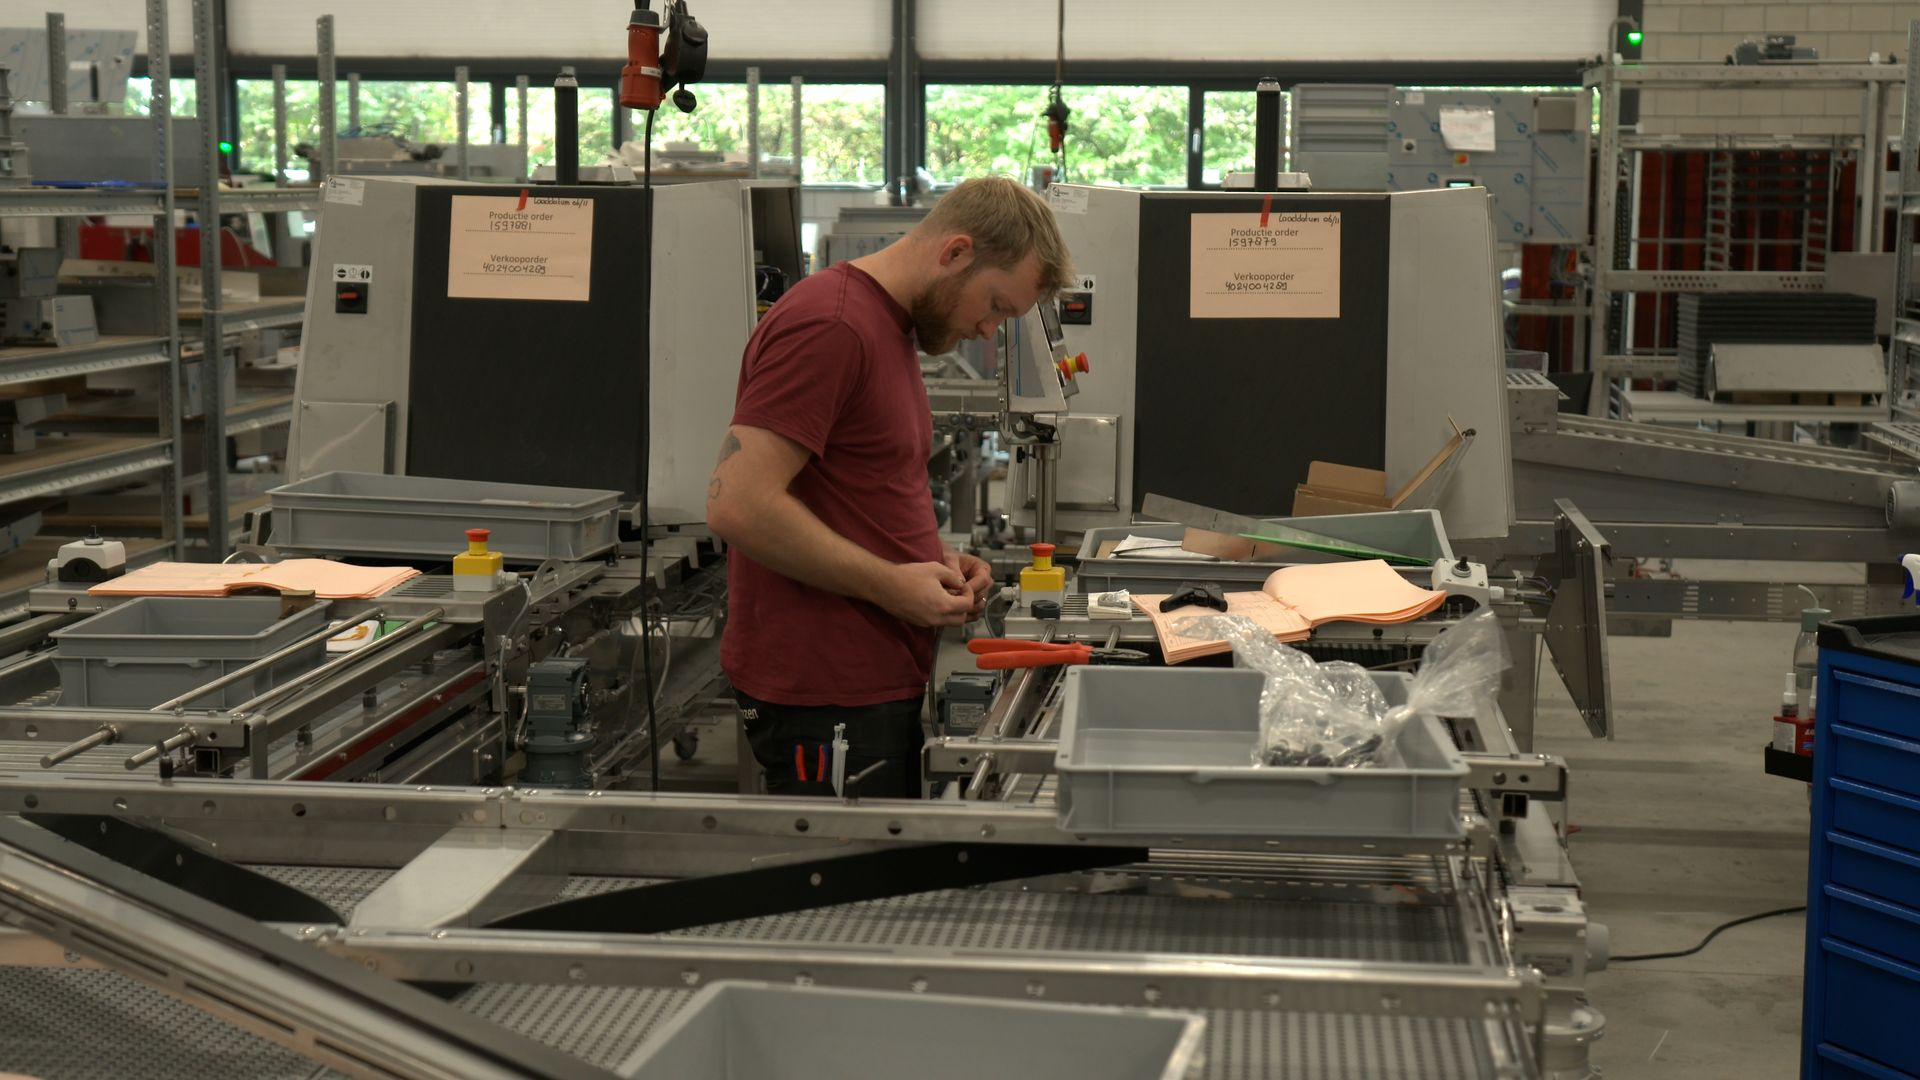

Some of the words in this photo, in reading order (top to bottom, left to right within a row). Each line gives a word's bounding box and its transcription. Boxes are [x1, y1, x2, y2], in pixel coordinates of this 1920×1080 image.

[489, 211, 529, 221] Productie
[530, 212, 554, 221] order
[489, 220, 532, 231] 1597881
[1230, 228, 1273, 237] Productie
[1274, 228, 1299, 237] order
[1228, 237, 1277, 247] 1597879
[490, 254, 549, 267] Verkooporder
[1233, 272, 1295, 283] Verkooporder
